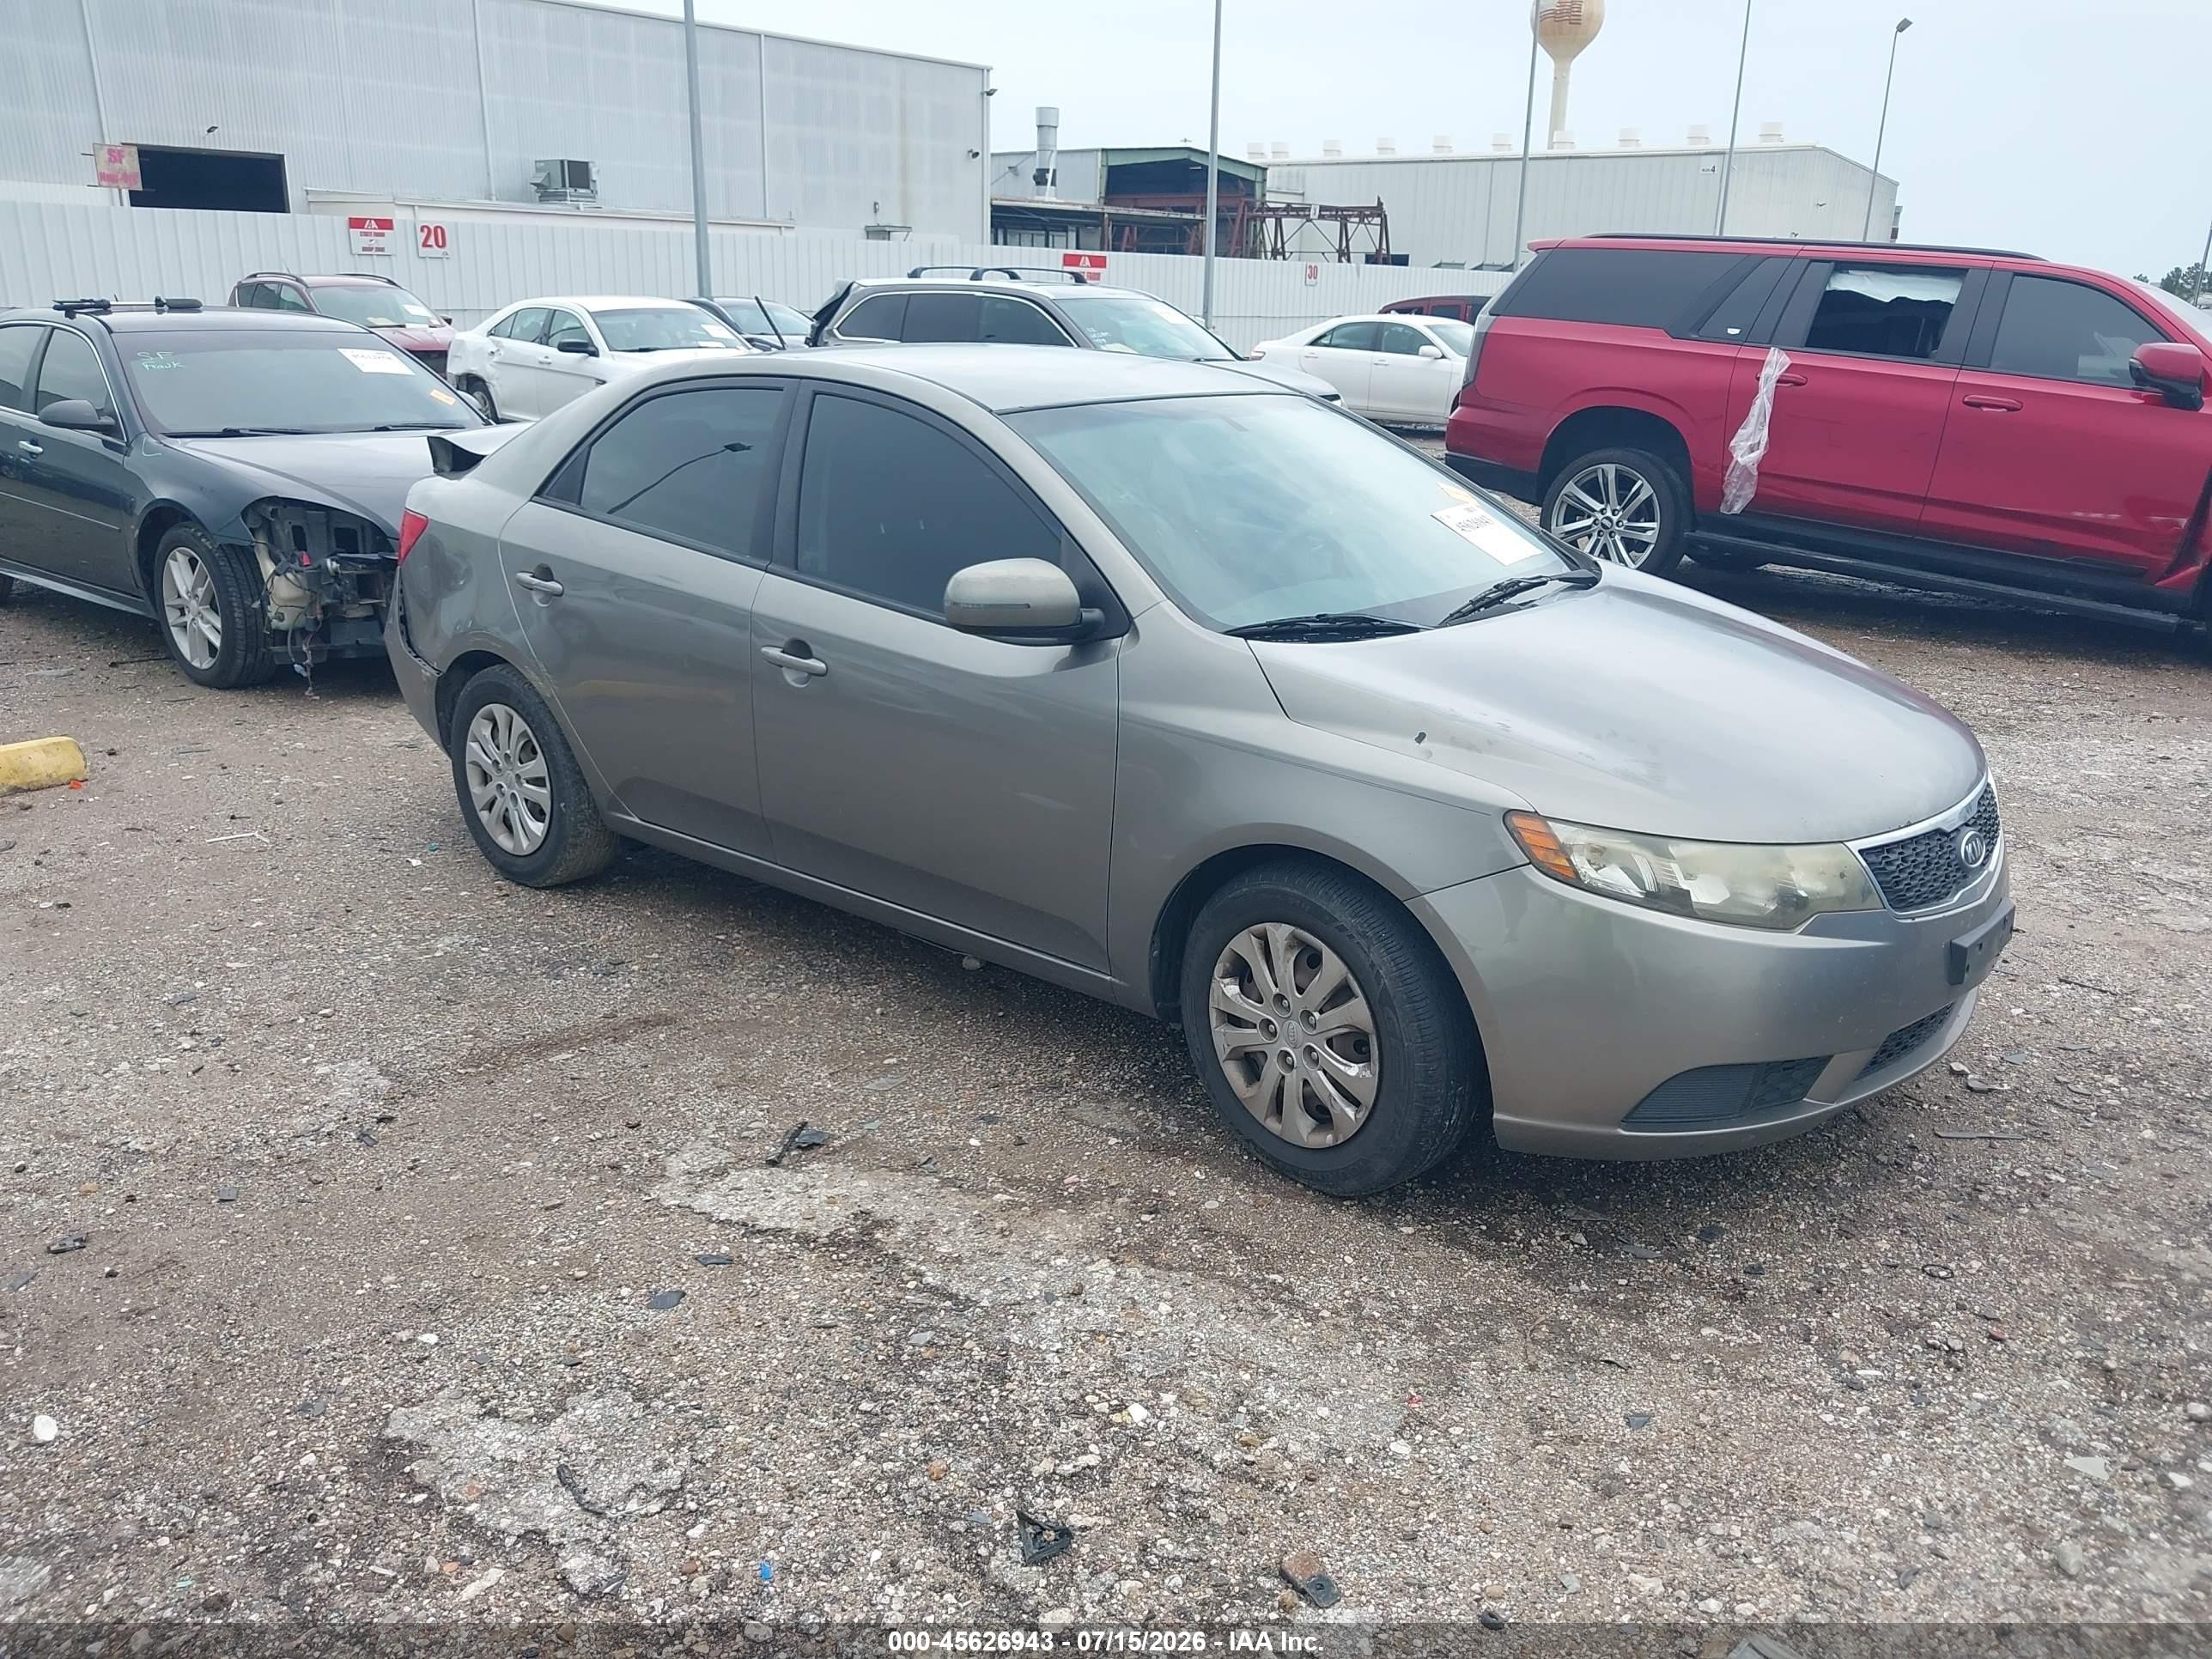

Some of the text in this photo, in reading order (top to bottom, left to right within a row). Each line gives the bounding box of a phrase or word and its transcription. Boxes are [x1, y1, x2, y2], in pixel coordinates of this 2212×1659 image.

[107, 149, 124, 164] SF
[420, 224, 447, 248] 20
[1308, 264, 1318, 280] 30
